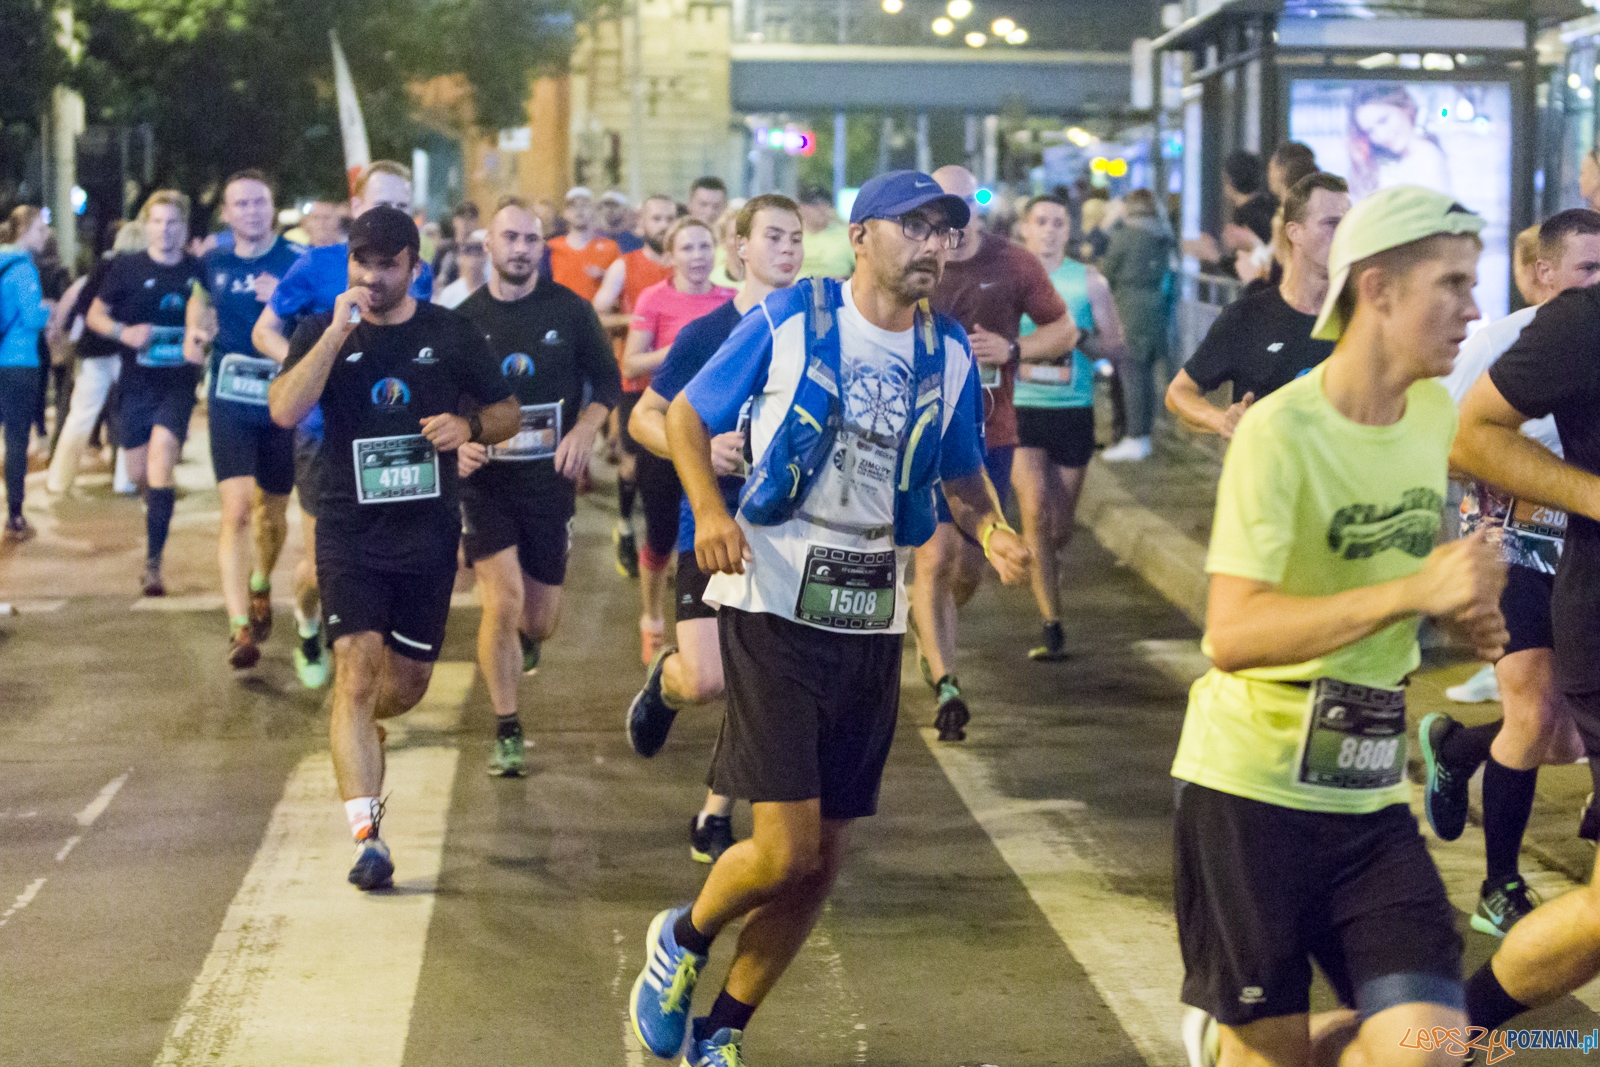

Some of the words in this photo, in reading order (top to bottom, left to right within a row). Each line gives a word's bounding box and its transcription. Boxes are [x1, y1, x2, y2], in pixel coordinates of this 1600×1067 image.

[379, 466, 420, 487] 4797
[1530, 505, 1568, 527] 250
[829, 588, 877, 616] 1508
